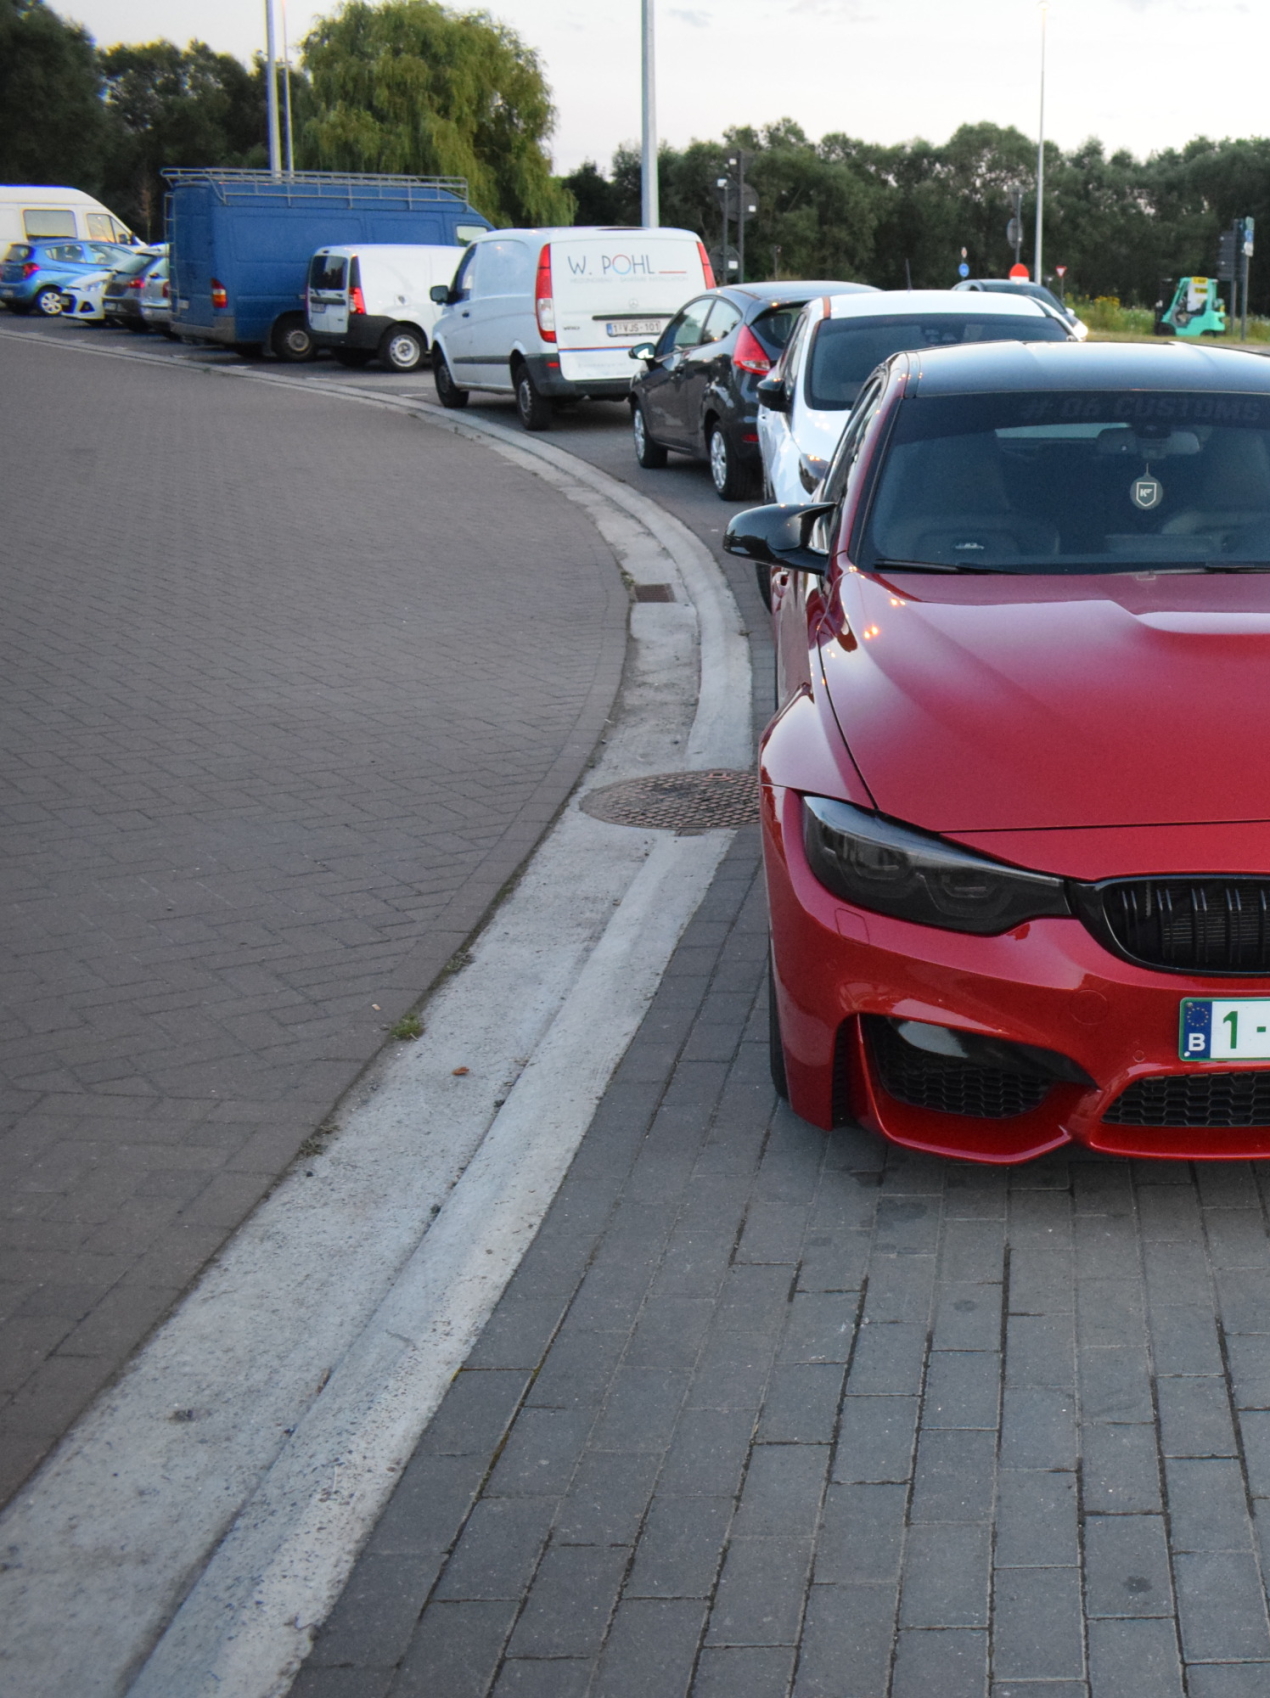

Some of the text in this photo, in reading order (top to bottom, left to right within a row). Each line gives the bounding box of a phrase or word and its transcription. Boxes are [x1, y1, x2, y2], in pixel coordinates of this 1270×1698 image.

[567, 254, 655, 275] W. POHL
[1114, 395, 1262, 421] CUSTOMS
[1188, 1032, 1206, 1051] B
